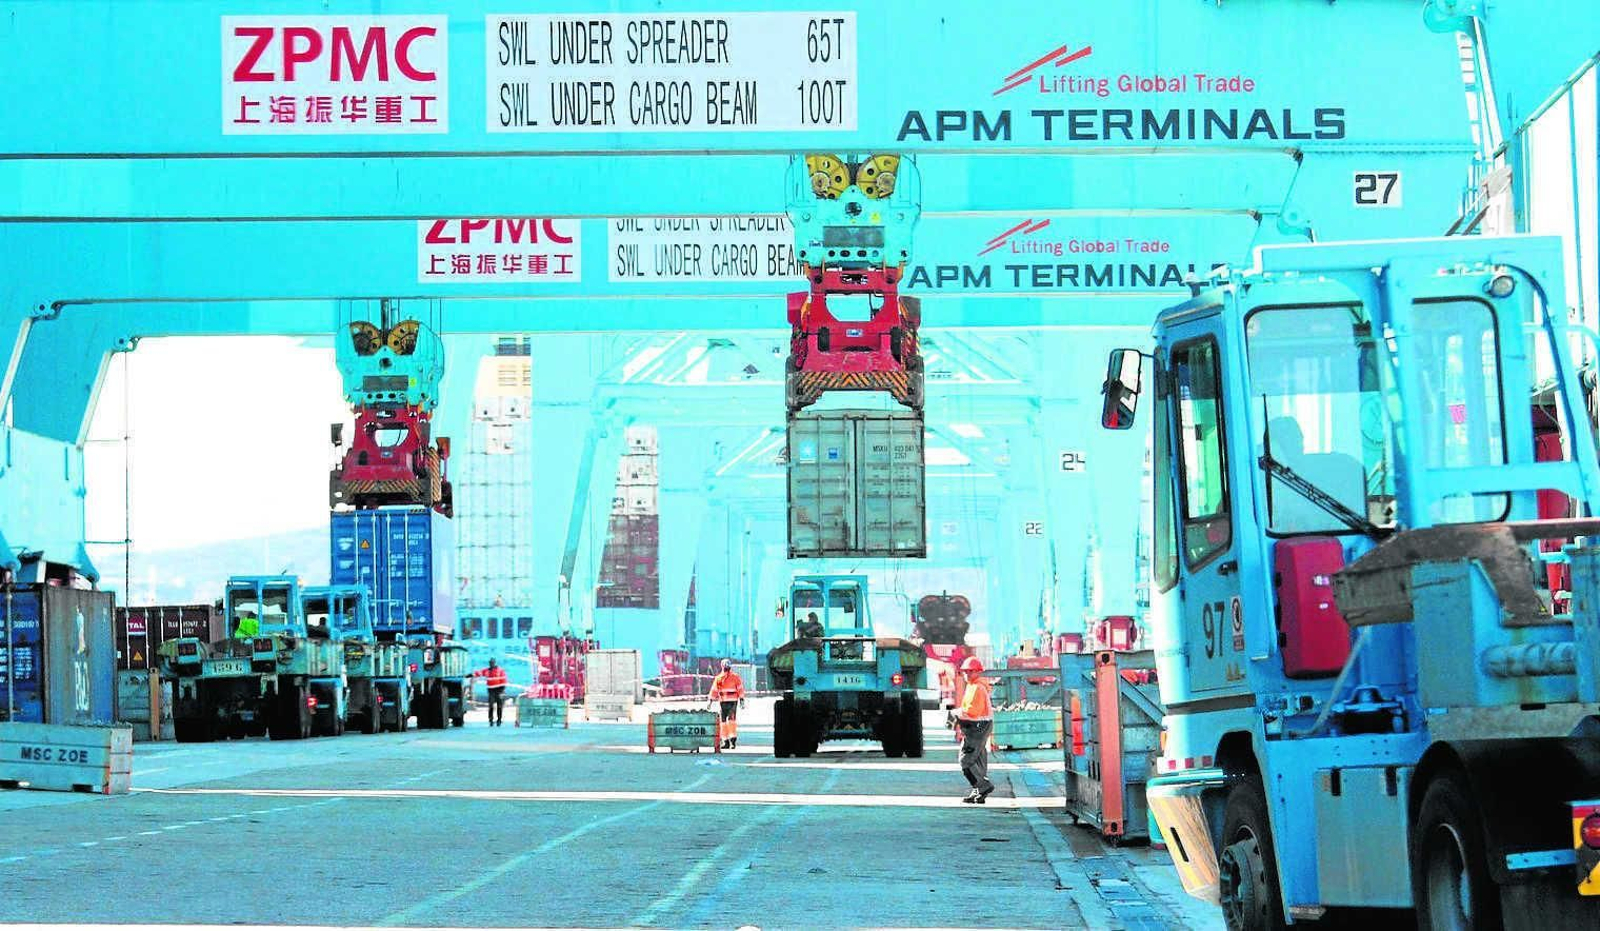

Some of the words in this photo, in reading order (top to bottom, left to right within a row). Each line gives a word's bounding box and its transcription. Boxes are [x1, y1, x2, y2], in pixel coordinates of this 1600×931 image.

[233, 27, 437, 82] ZPMC
[499, 21, 536, 67] SWL
[550, 20, 613, 66] UNDER
[626, 20, 729, 65] SPREADER
[807, 19, 845, 62] 65T
[1039, 73, 1110, 97] Lifting
[1117, 73, 1187, 95] Global
[1194, 74, 1256, 95] Trade
[233, 95, 437, 123] 上海振华重工
[500, 81, 538, 127] SWL
[551, 81, 616, 127] UNDER
[629, 81, 693, 126] CARGO
[706, 80, 757, 125] BEAM
[797, 79, 847, 125] 100T
[896, 109, 1011, 142] APM
[1031, 108, 1346, 140] TERMINALS
[1354, 173, 1399, 205] 27
[617, 244, 645, 277] SWL
[656, 244, 702, 276] UNDER
[711, 244, 758, 276] CARGO
[1010, 239, 1062, 257] Lifting
[1069, 238, 1120, 254] Global
[1125, 238, 1170, 254] Trade
[425, 253, 574, 275] 上海振华重工
[908, 264, 991, 288] APM
[1062, 453, 1086, 471] 24
[1025, 522, 1042, 535] 22
[1202, 601, 1226, 660] 97
[20, 746, 52, 761] MSC
[58, 748, 89, 764] ZOE
